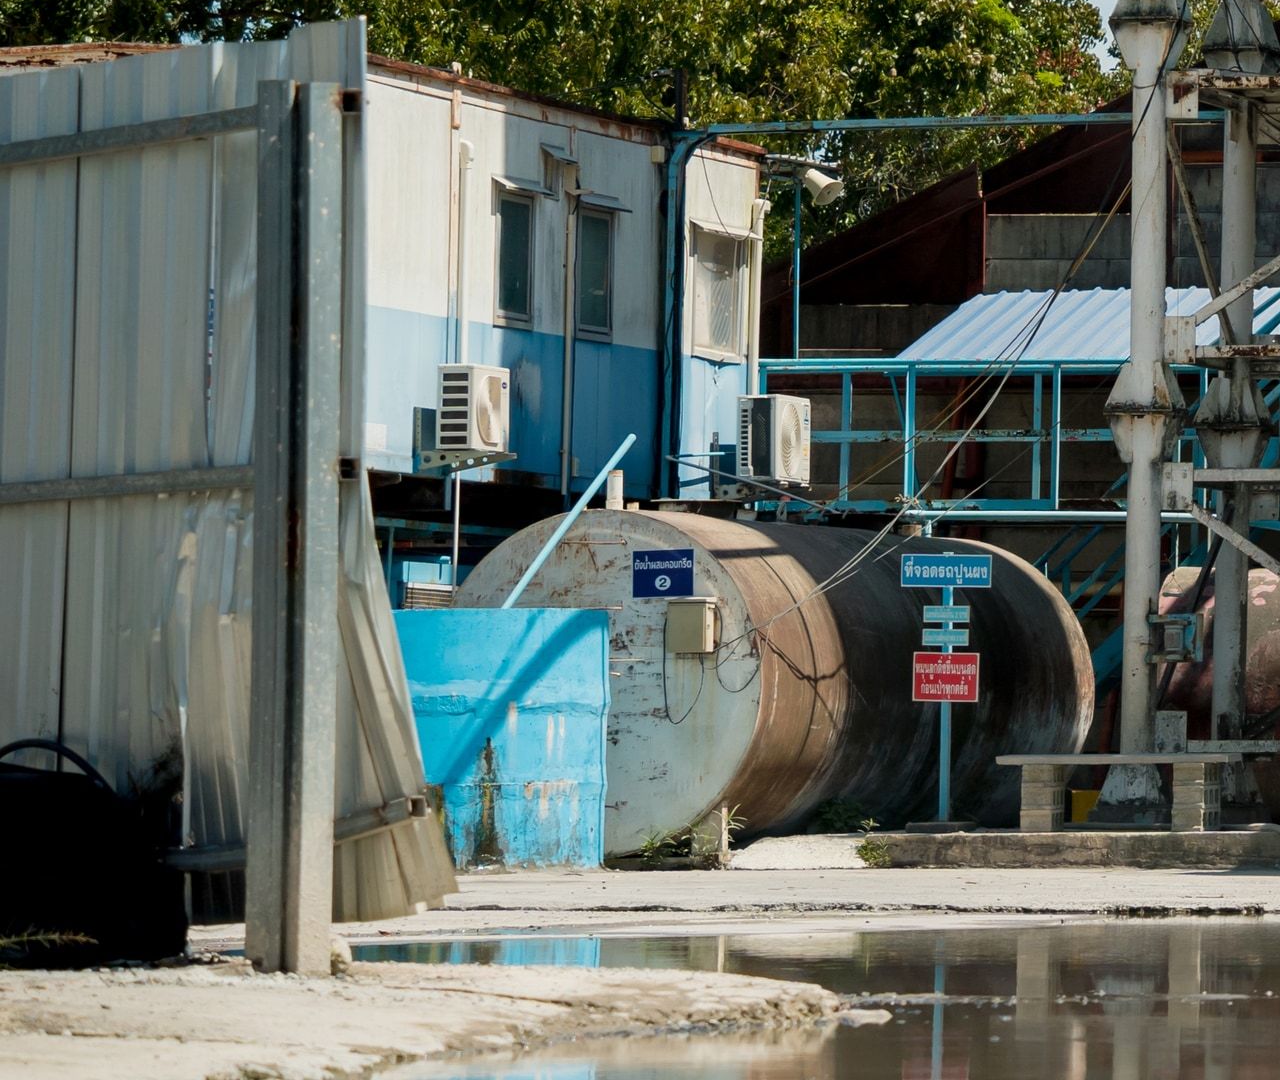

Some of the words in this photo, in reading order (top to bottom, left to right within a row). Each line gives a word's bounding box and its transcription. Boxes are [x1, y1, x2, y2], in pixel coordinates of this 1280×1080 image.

[904, 556, 988, 584] ที่จอดรถปูนผง
